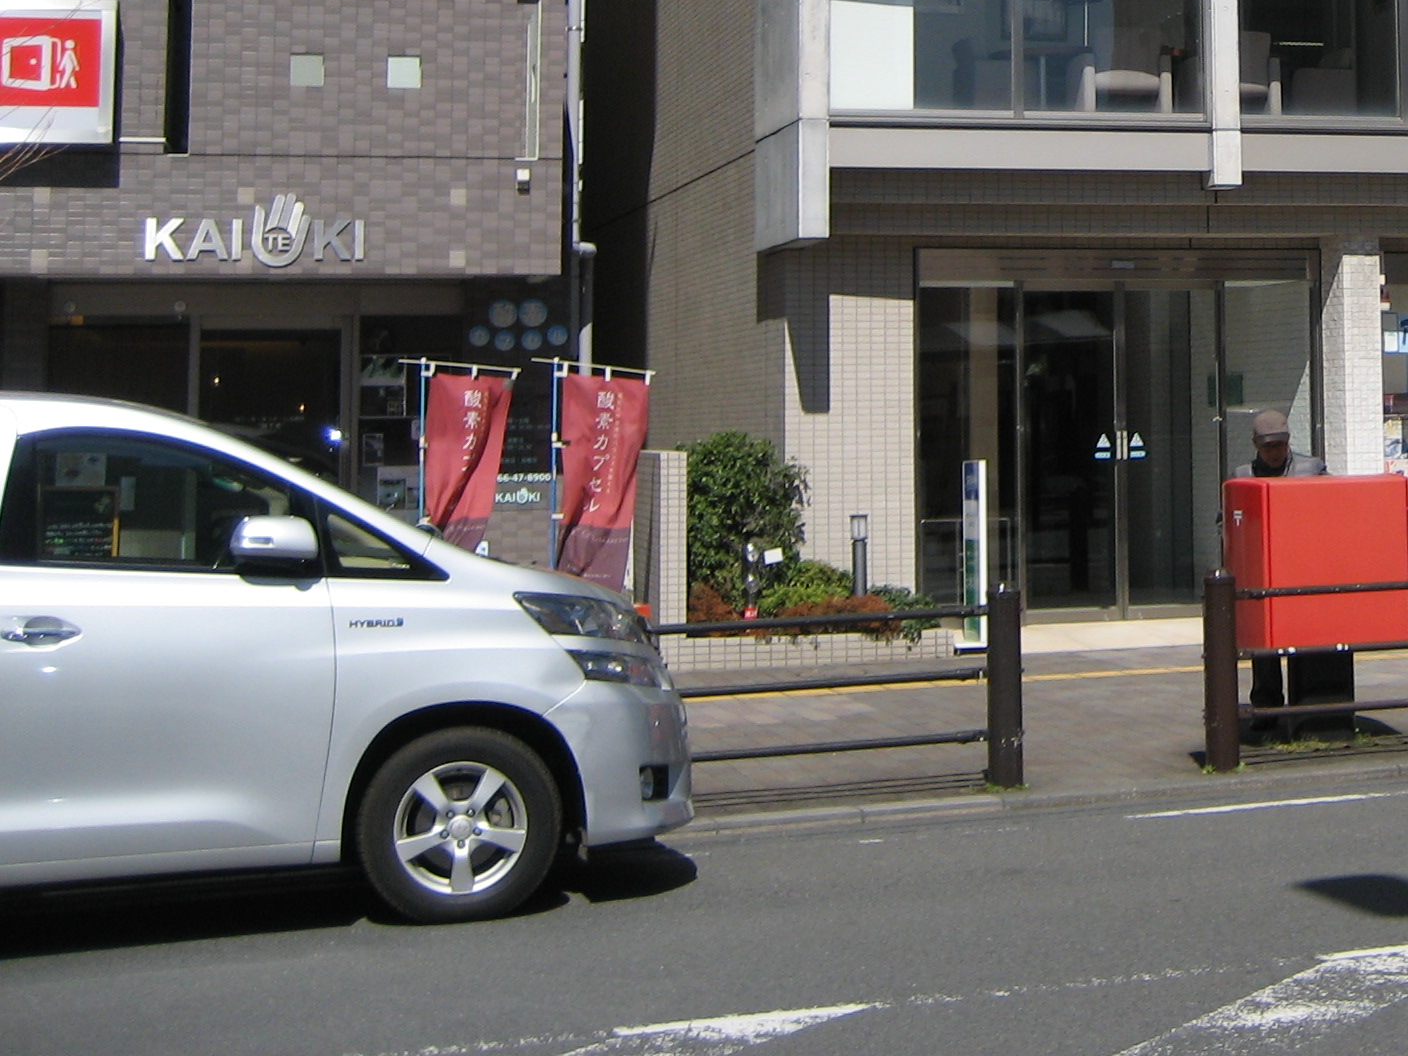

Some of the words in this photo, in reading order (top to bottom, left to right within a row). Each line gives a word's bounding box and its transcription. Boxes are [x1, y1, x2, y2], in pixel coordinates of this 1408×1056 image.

[583, 390, 615, 512] 酸素カプセル
[349, 619, 396, 629] HYBRID
